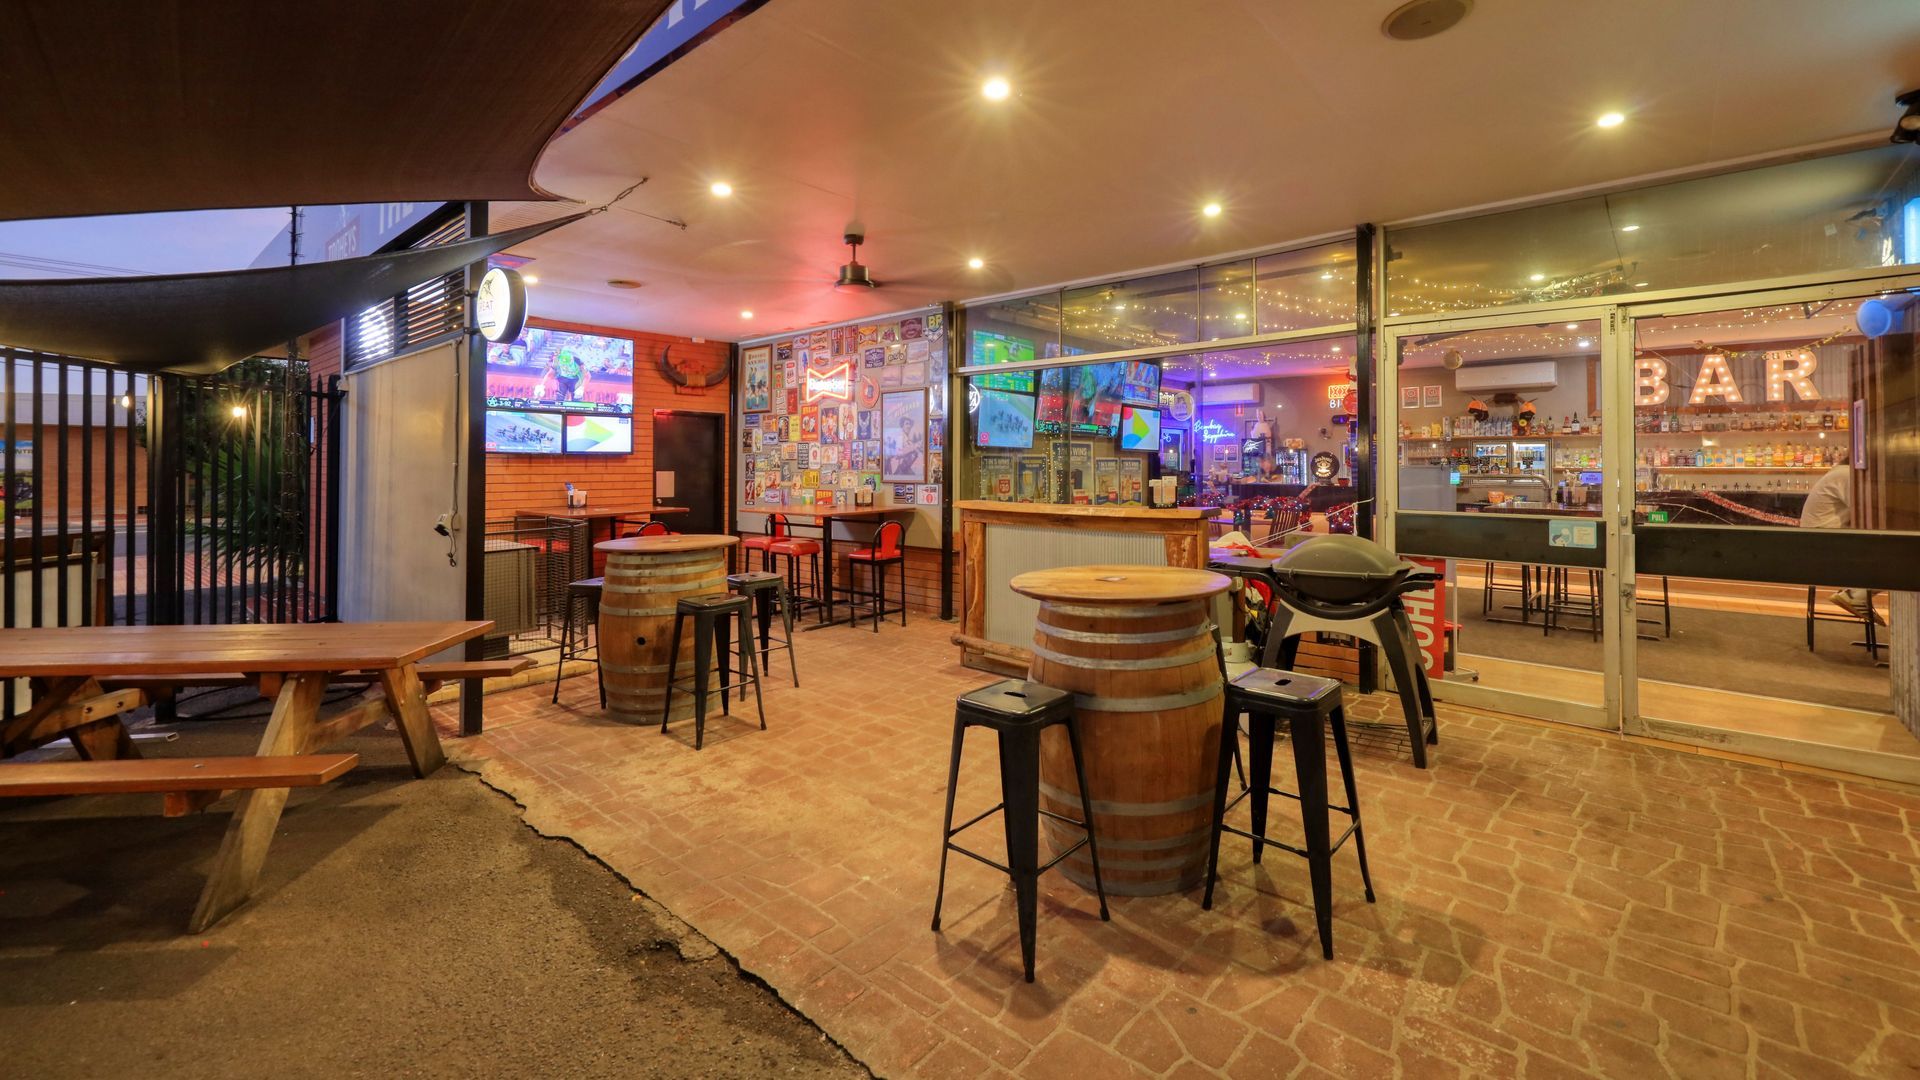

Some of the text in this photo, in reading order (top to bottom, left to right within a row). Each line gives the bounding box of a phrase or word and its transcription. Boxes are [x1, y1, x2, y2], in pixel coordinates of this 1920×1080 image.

[928, 314, 943, 329] BP
[1634, 349, 1822, 406] BAR
[1193, 419, 1222, 433] Bombay
[1073, 447, 1088, 457] WINS
[1651, 512, 1665, 522] PULL
